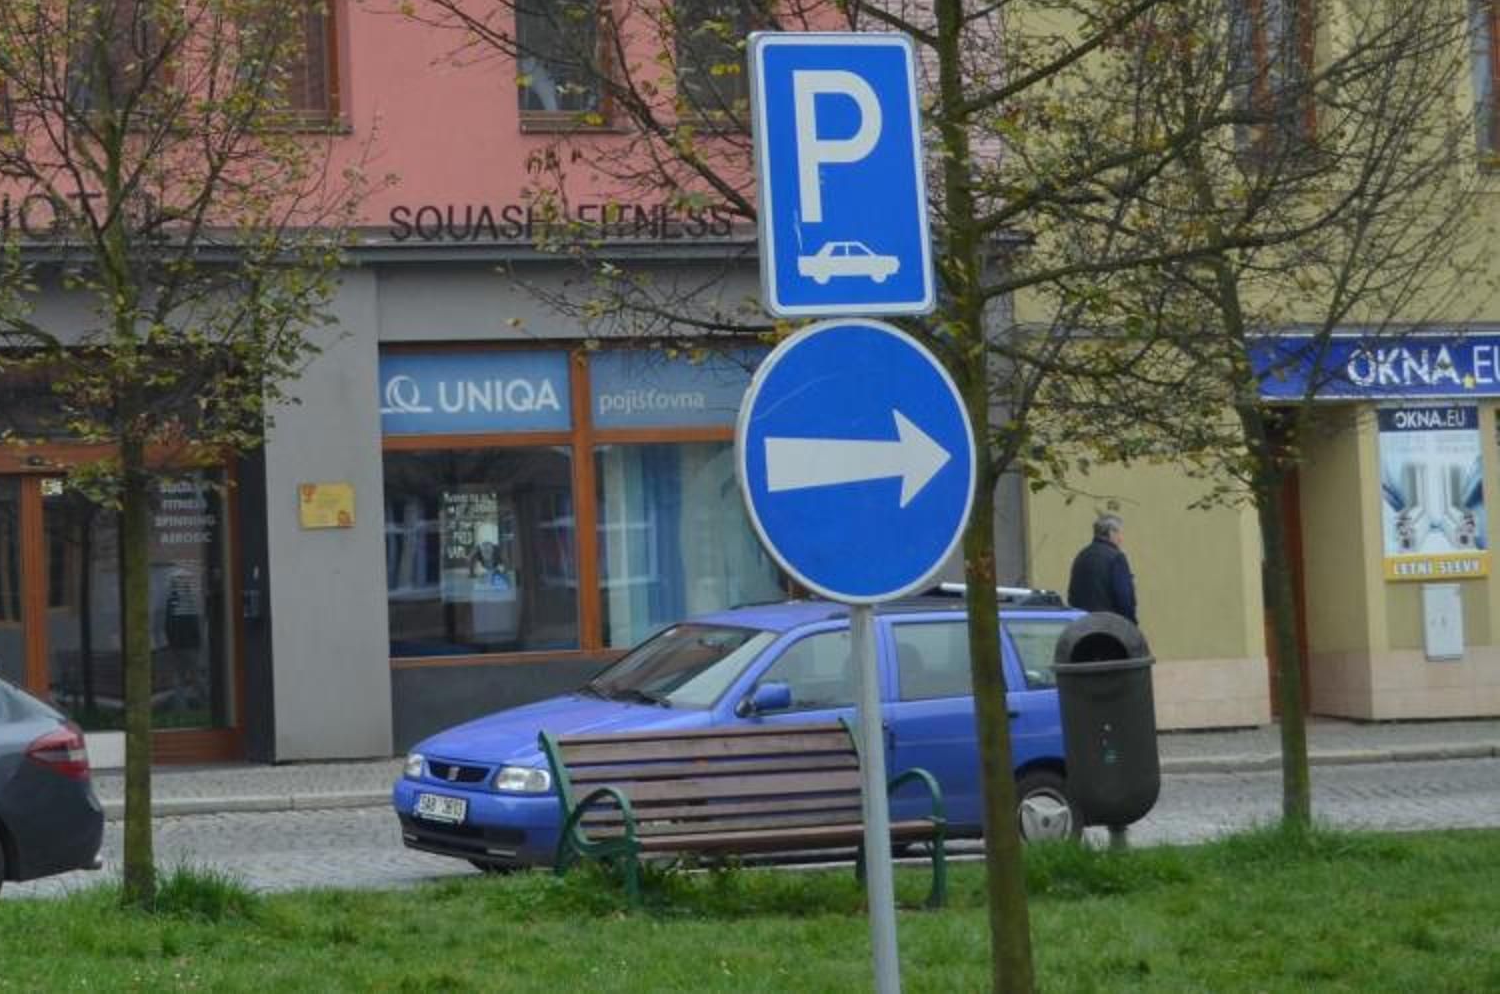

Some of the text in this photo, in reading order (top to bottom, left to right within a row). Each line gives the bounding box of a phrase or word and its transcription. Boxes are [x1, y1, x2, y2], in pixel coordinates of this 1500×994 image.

[792, 69, 883, 223] P
[580, 203, 732, 240] FITNESS
[438, 378, 560, 413] UNIQA
